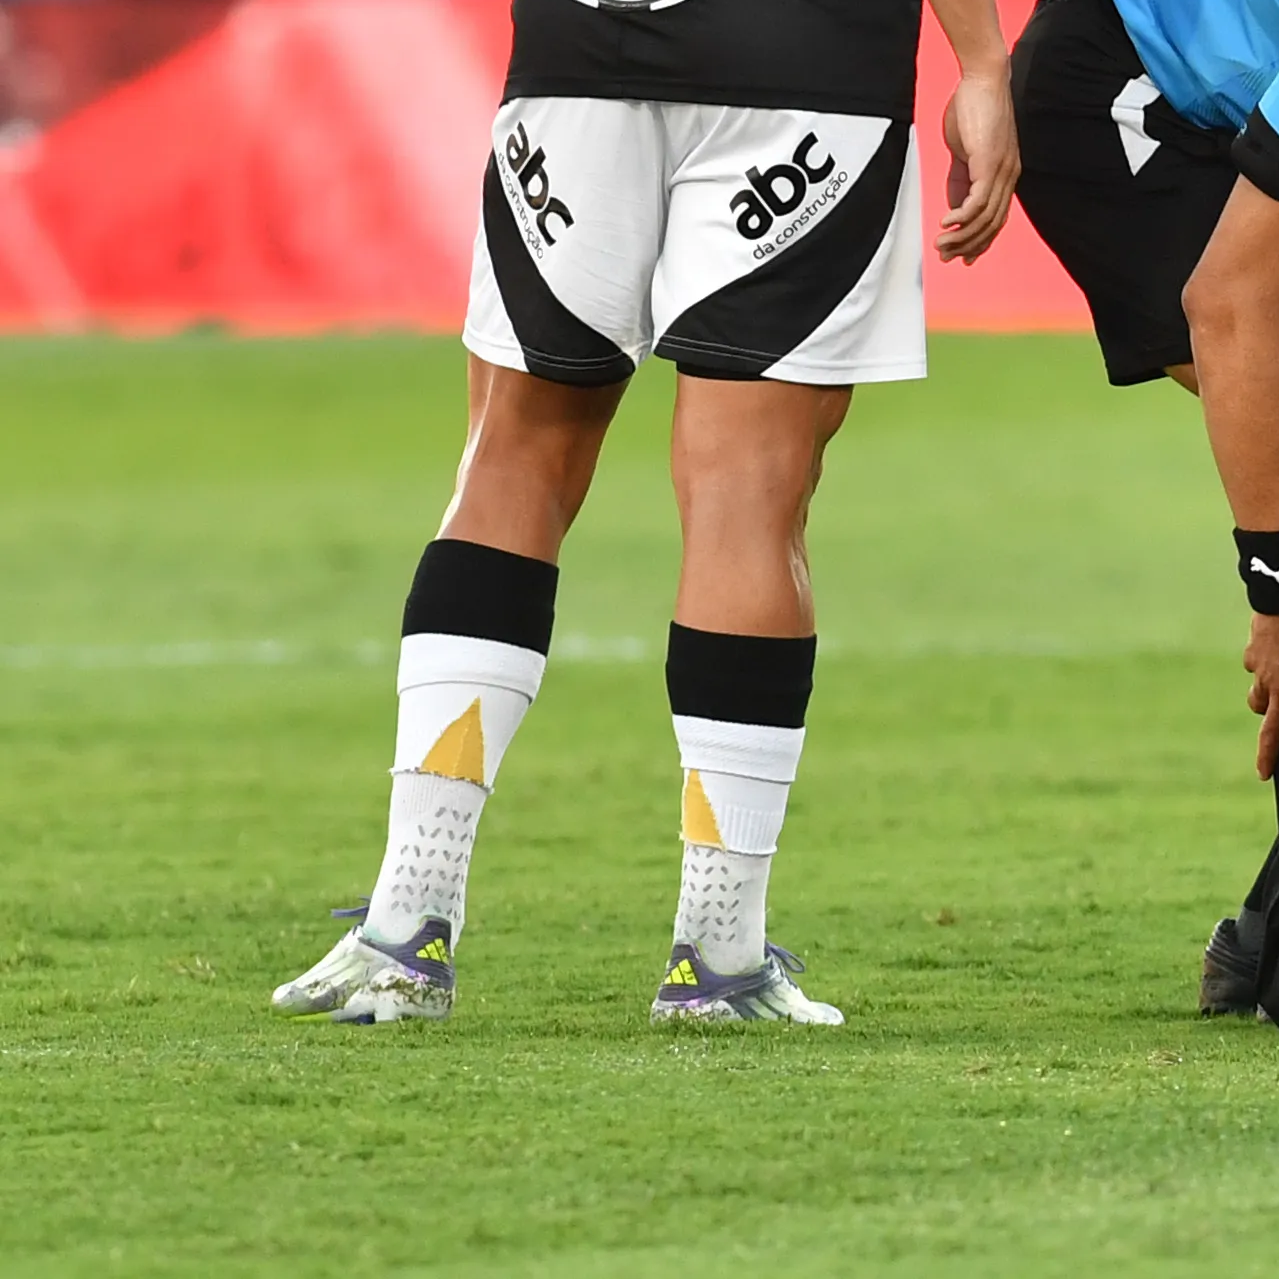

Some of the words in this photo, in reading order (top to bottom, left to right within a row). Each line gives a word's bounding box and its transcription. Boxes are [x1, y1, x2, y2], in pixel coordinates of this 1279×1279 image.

[506, 120, 575, 247] abc
[729, 132, 836, 241] abc
[752, 241, 776, 261] da
[775, 169, 848, 244] construção
